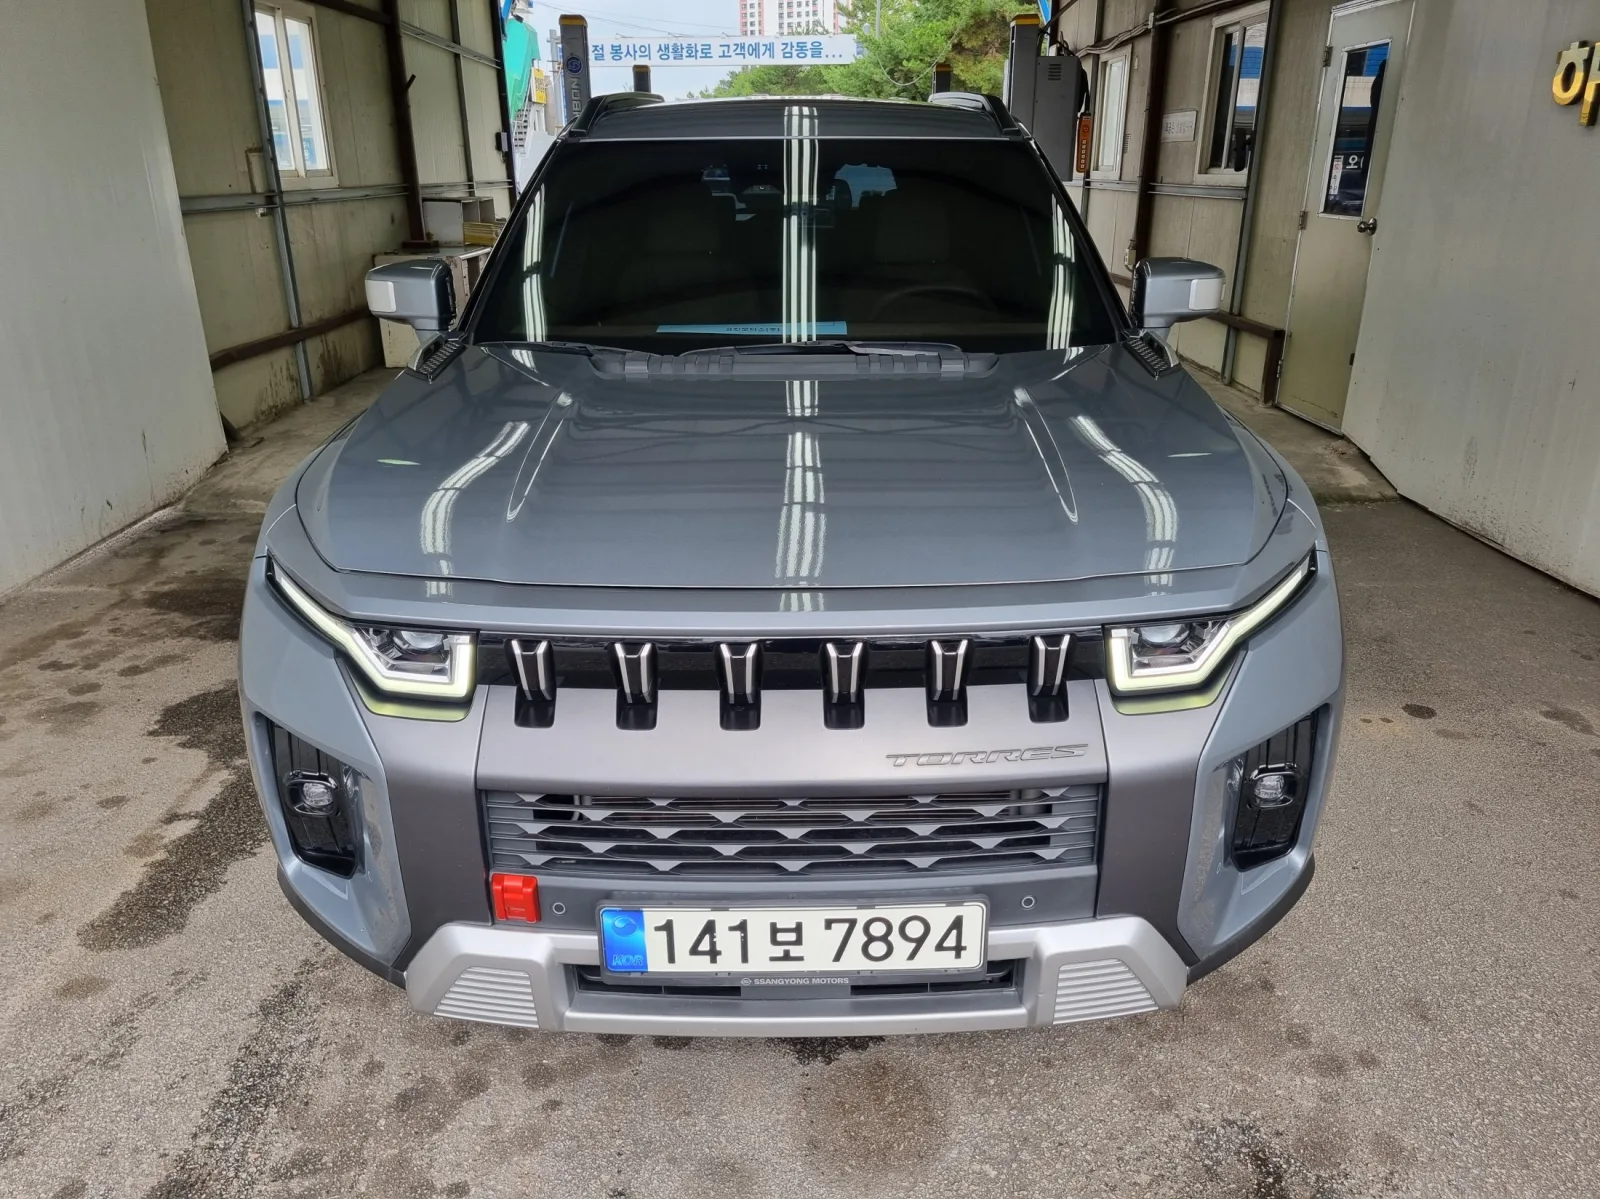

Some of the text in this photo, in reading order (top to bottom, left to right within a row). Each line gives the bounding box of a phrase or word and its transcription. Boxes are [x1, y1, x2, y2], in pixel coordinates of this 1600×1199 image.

[610, 43, 651, 61] 봉사의
[657, 42, 713, 61] 생활화로
[718, 42, 775, 60] 고객에게
[886, 744, 1088, 767] TORRES
[612, 954, 644, 966] KOR
